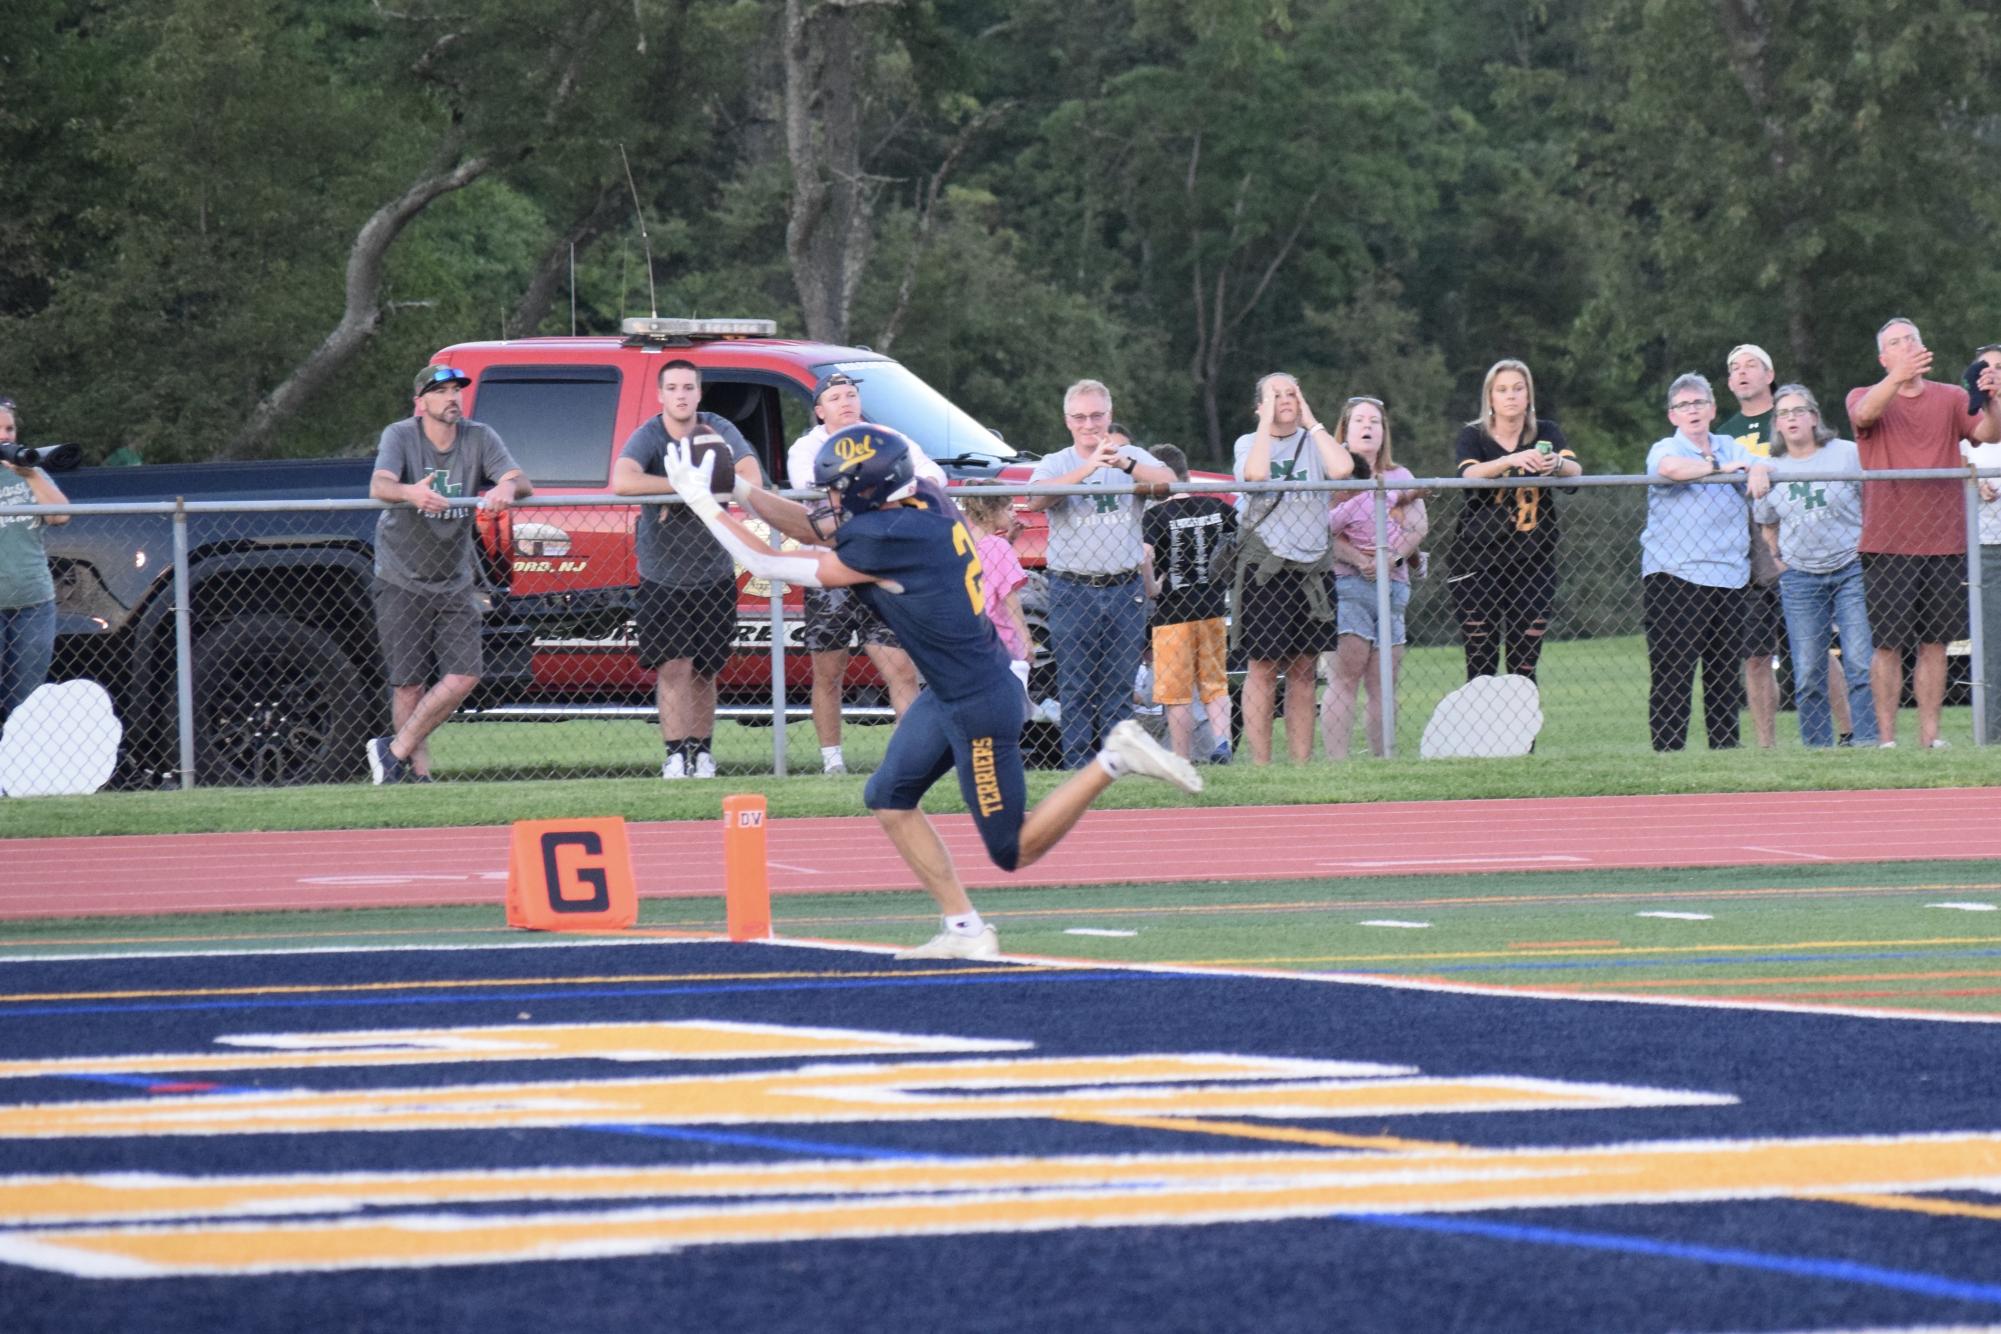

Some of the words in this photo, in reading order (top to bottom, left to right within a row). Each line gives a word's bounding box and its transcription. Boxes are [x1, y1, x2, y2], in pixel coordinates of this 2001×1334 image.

[835, 435, 875, 466] Del
[952, 521, 986, 616] 2
[972, 736, 1004, 817] TERRIERS
[740, 811, 762, 826] DV
[541, 831, 610, 913] G
